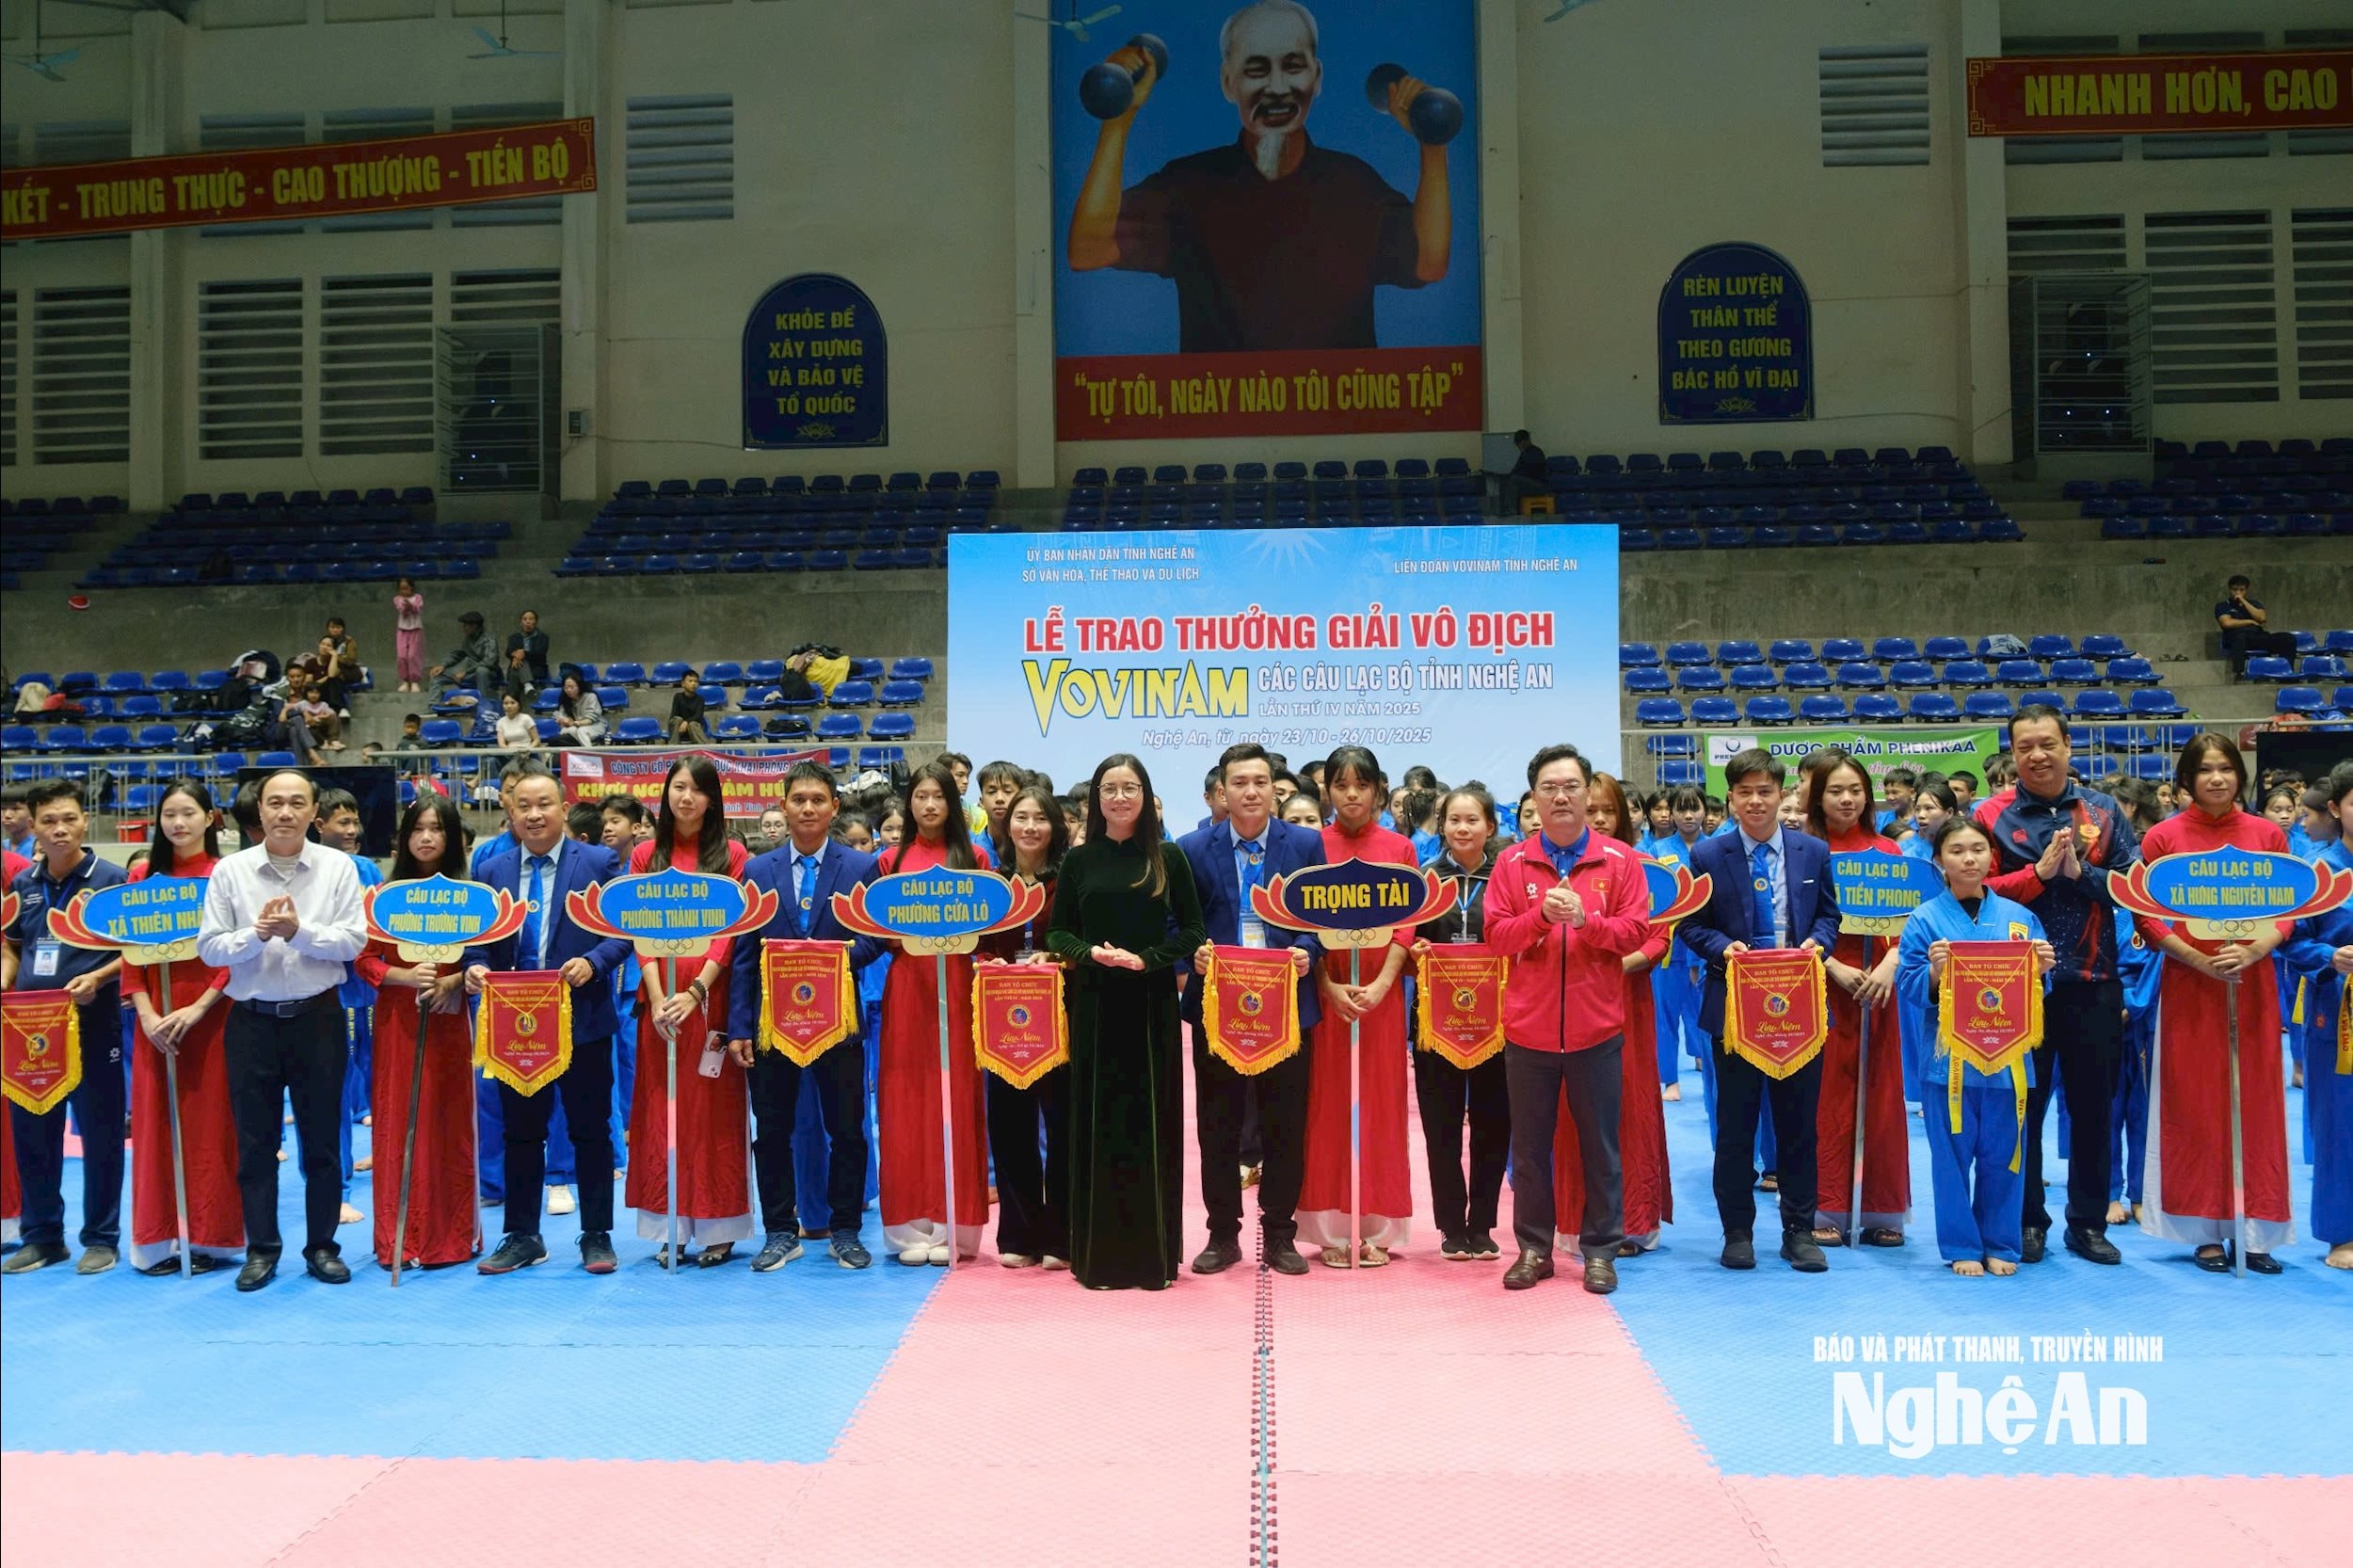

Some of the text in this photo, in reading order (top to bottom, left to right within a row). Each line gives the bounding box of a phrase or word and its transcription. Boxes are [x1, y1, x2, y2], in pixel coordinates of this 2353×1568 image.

[2025, 66, 2338, 116] NHANH HƠN, CAO
[2, 136, 569, 225] KẾT TRUNG THỰC CAO THƯỢNG TIẾN BỘ
[1683, 273, 1784, 298] RÈN LUYỆN
[776, 305, 856, 329] KHỎE ĐỂ
[1690, 299, 1779, 328] THÂN THỂ
[769, 338, 863, 360] XÂY DỰNG
[1678, 336, 1792, 359] THEO GƯƠNG
[768, 363, 864, 388] VÀ BẢO VỆ
[1672, 363, 1799, 392] BÁC HỒ VĨ ĐẠI
[776, 391, 856, 416] TỔ QUỐC
[1121, 373, 1163, 420] TÔI,
[1171, 371, 1232, 415] NGÀY
[1239, 370, 1287, 413] NÀO
[1293, 369, 1330, 412] TÔI
[1337, 367, 1401, 410] CŨNG
[1044, 549, 1064, 561] BAN
[1180, 547, 1194, 560] AN
[1452, 560, 1500, 572] VOVINAM
[1562, 559, 1577, 571] AN
[1112, 568, 1139, 581] THAO
[1159, 568, 1174, 581] DU
[1024, 602, 1555, 655] LỄ TRAO THƯỞNG GIẢI VÔ ĐỊCH
[1257, 657, 1553, 696] CÁC CÂU LẠC BỘ TỈNH NGHỆ AN
[1021, 659, 1249, 738] VOVINAM
[1258, 697, 1421, 717] LẦN THỨ IV NĂM 2025
[1143, 729, 1182, 750] Nghệ
[1186, 730, 1212, 747] An,
[1215, 728, 1233, 745] từ
[1240, 729, 1278, 748] ngày
[1281, 728, 1328, 745] 23/10
[1339, 728, 1433, 745] 26/10/2025
[1888, 741, 1976, 754] PHENIKAA
[611, 760, 635, 775] CÔNG
[637, 761, 648, 775] TY
[722, 778, 754, 797] ẢM
[1837, 859, 1909, 882] CÂU LẠC BỘ
[2188, 858, 2273, 880] CÂU LẠC BỘ
[121, 882, 198, 907] CÂU LẠC BỘ
[406, 887, 469, 908] CÂU LẠC BỘ
[636, 881, 709, 901] CÂU LẠC BỘ
[902, 877, 974, 898] CÂU LẠC BỘ
[1301, 877, 1410, 914] TRỌNG TÀI
[1845, 882, 1874, 905] TIỀN
[1877, 889, 1921, 908] PHONG
[2169, 883, 2295, 905] XÃ HƯNG NGUYÊN NAM
[107, 903, 203, 937] XÃ THIÊN NHẪ
[388, 910, 481, 934] PHƯỜNG TRƯỜNG VINH
[621, 905, 726, 929] PHƯỜNG THÀNH VINH
[888, 898, 988, 924] PHƯỜNG CỬA LÒ
